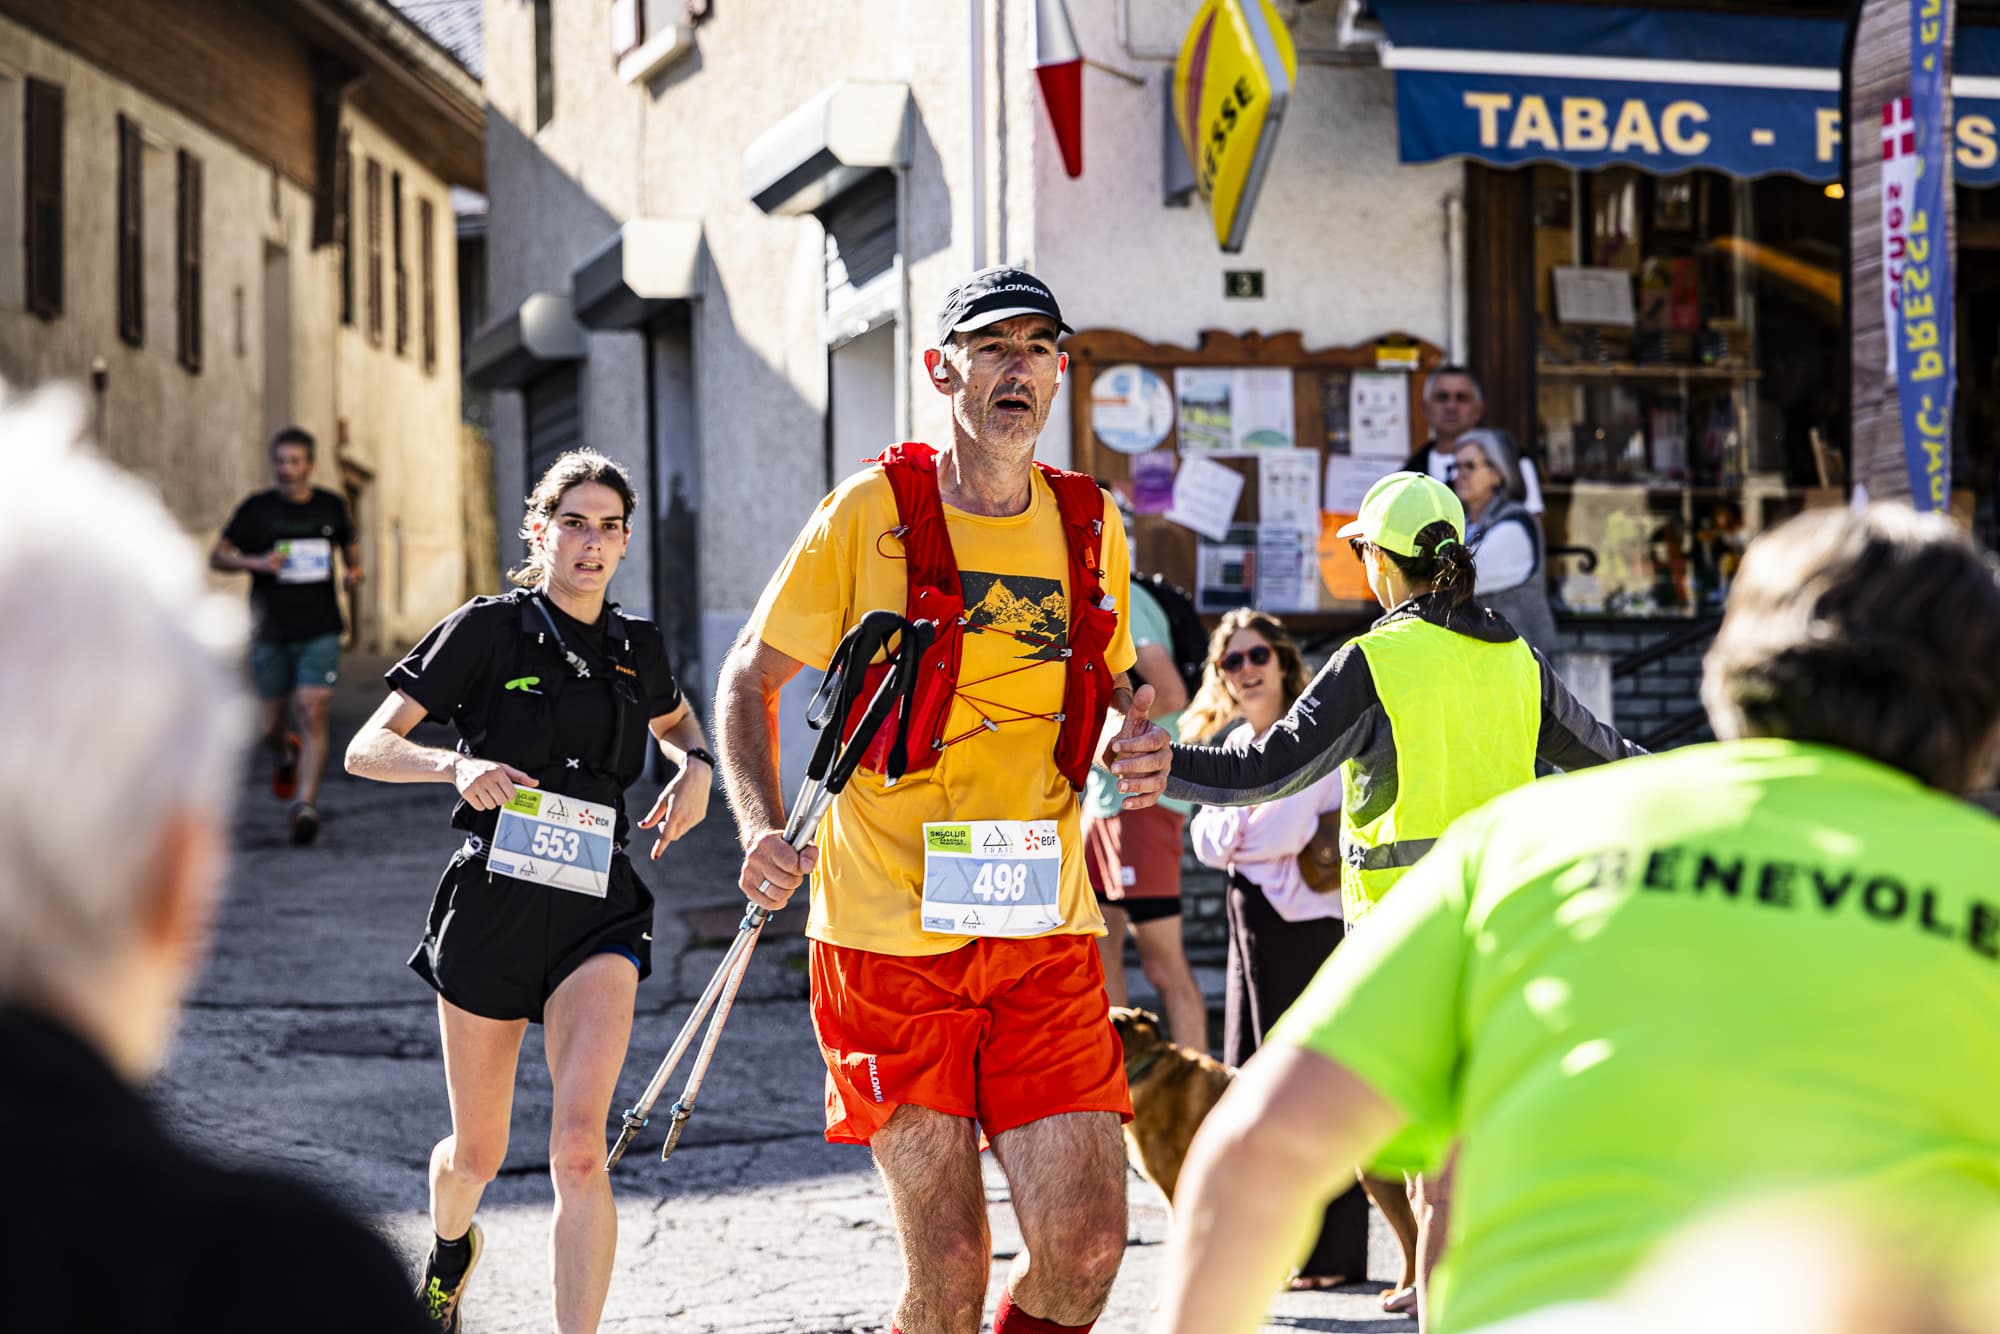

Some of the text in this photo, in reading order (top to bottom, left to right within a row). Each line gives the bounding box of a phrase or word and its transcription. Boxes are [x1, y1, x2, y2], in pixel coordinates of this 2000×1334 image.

[1463, 92, 1710, 155] TABAC
[531, 825, 580, 862] 553
[972, 862, 1028, 902] 498
